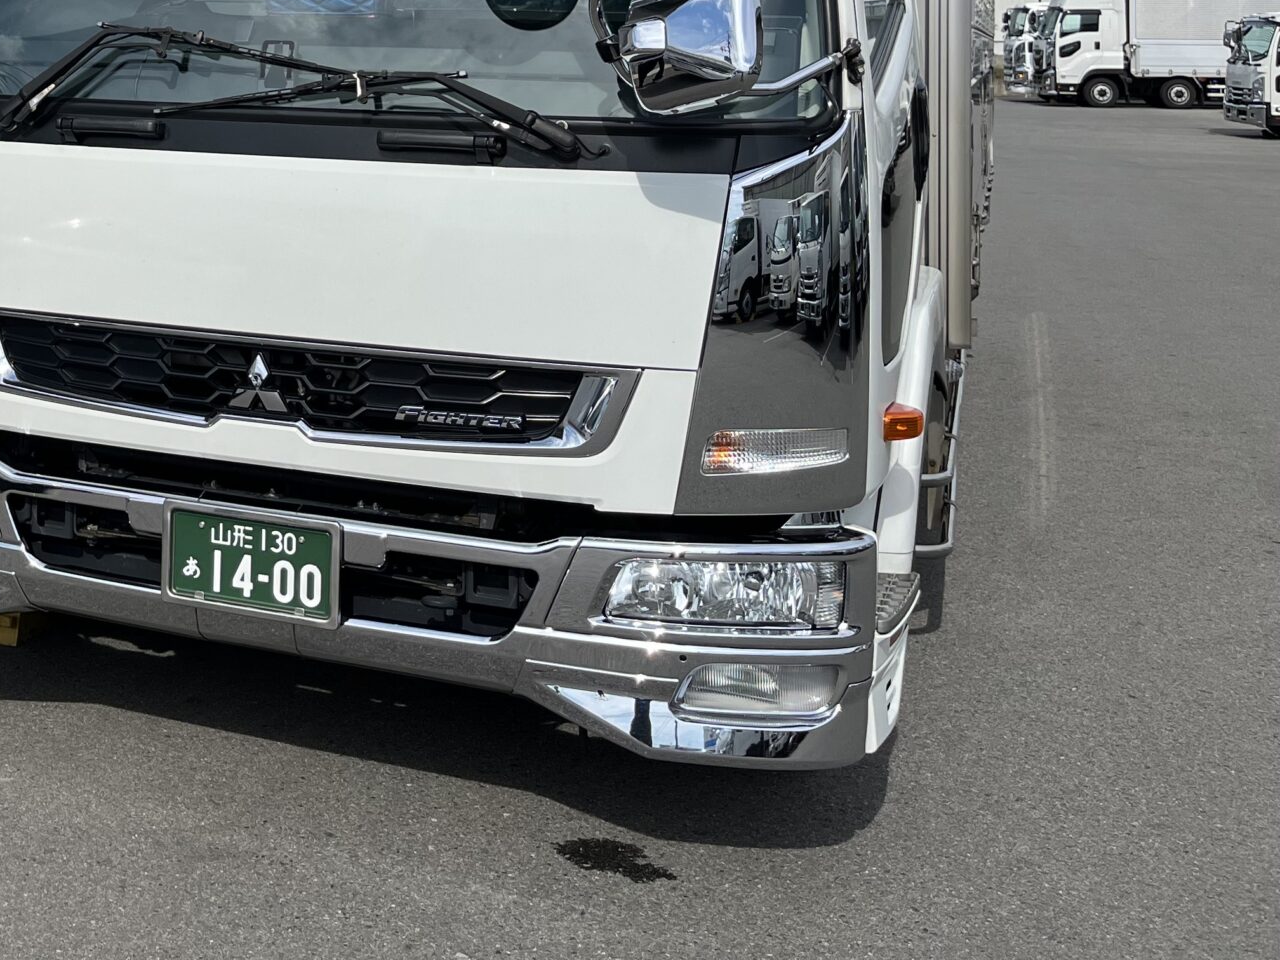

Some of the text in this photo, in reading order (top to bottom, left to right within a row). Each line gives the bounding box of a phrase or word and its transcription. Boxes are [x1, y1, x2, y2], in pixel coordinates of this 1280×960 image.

[394, 405, 523, 429] FIGHTER
[210, 523, 297, 555] 山形 130
[182, 549, 322, 608] あ 14-00
